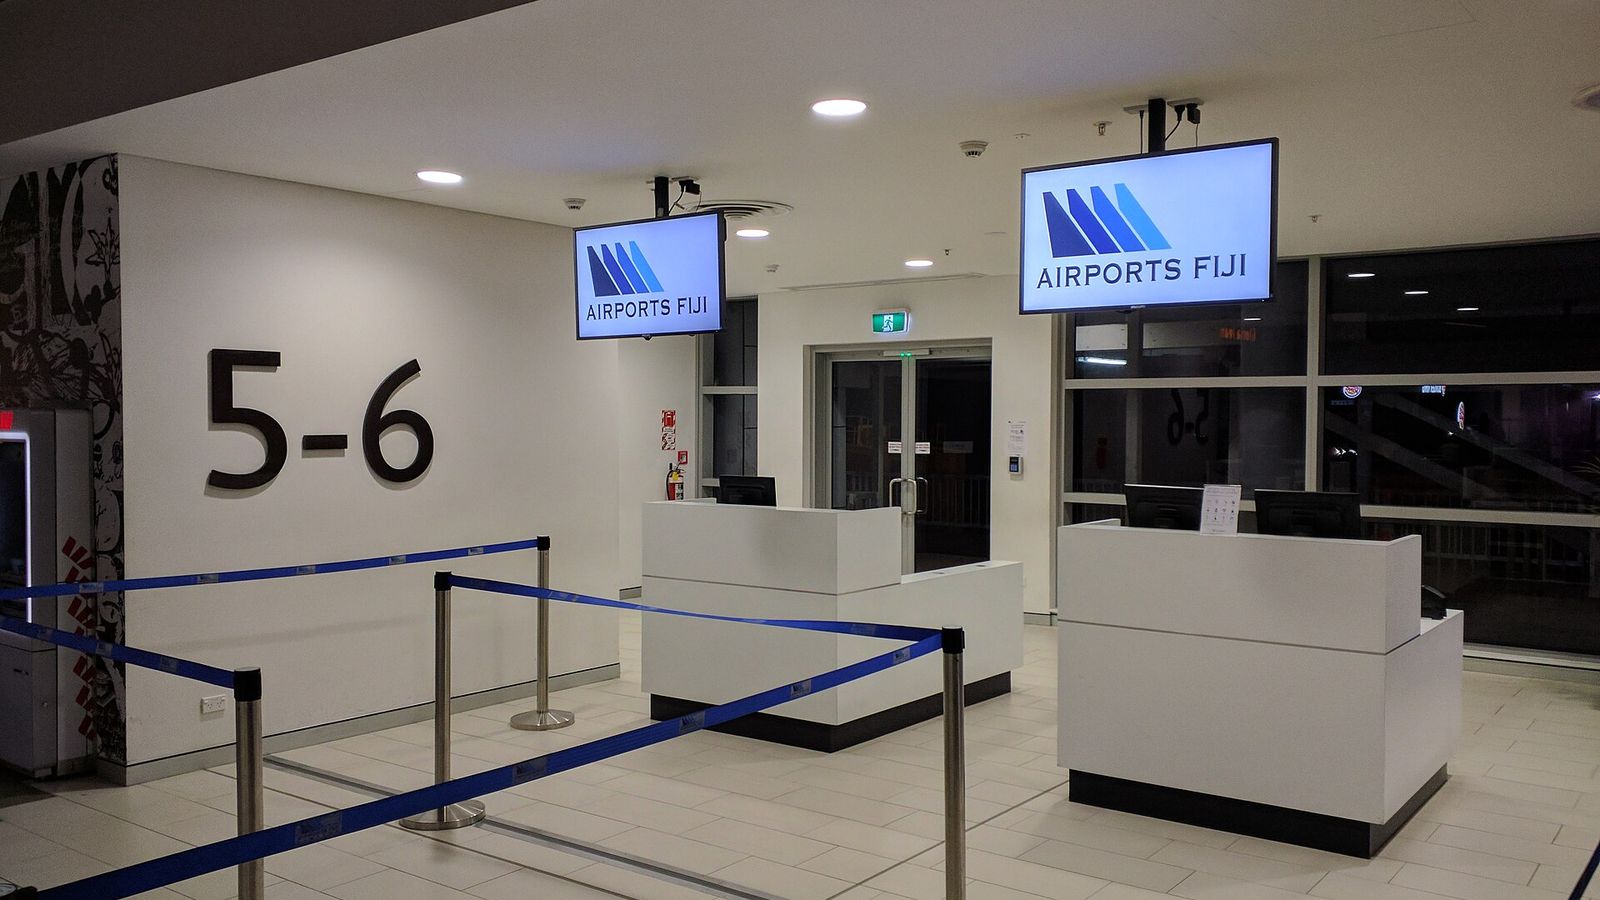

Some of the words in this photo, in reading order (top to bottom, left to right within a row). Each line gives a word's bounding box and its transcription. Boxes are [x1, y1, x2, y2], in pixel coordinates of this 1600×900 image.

[1036, 258, 1181, 289] AIRPORTS
[1193, 253, 1247, 279] FIJI
[586, 299, 671, 321] AIRPORTS
[677, 296, 707, 315] FIJI
[209, 348, 434, 490] 5-6
